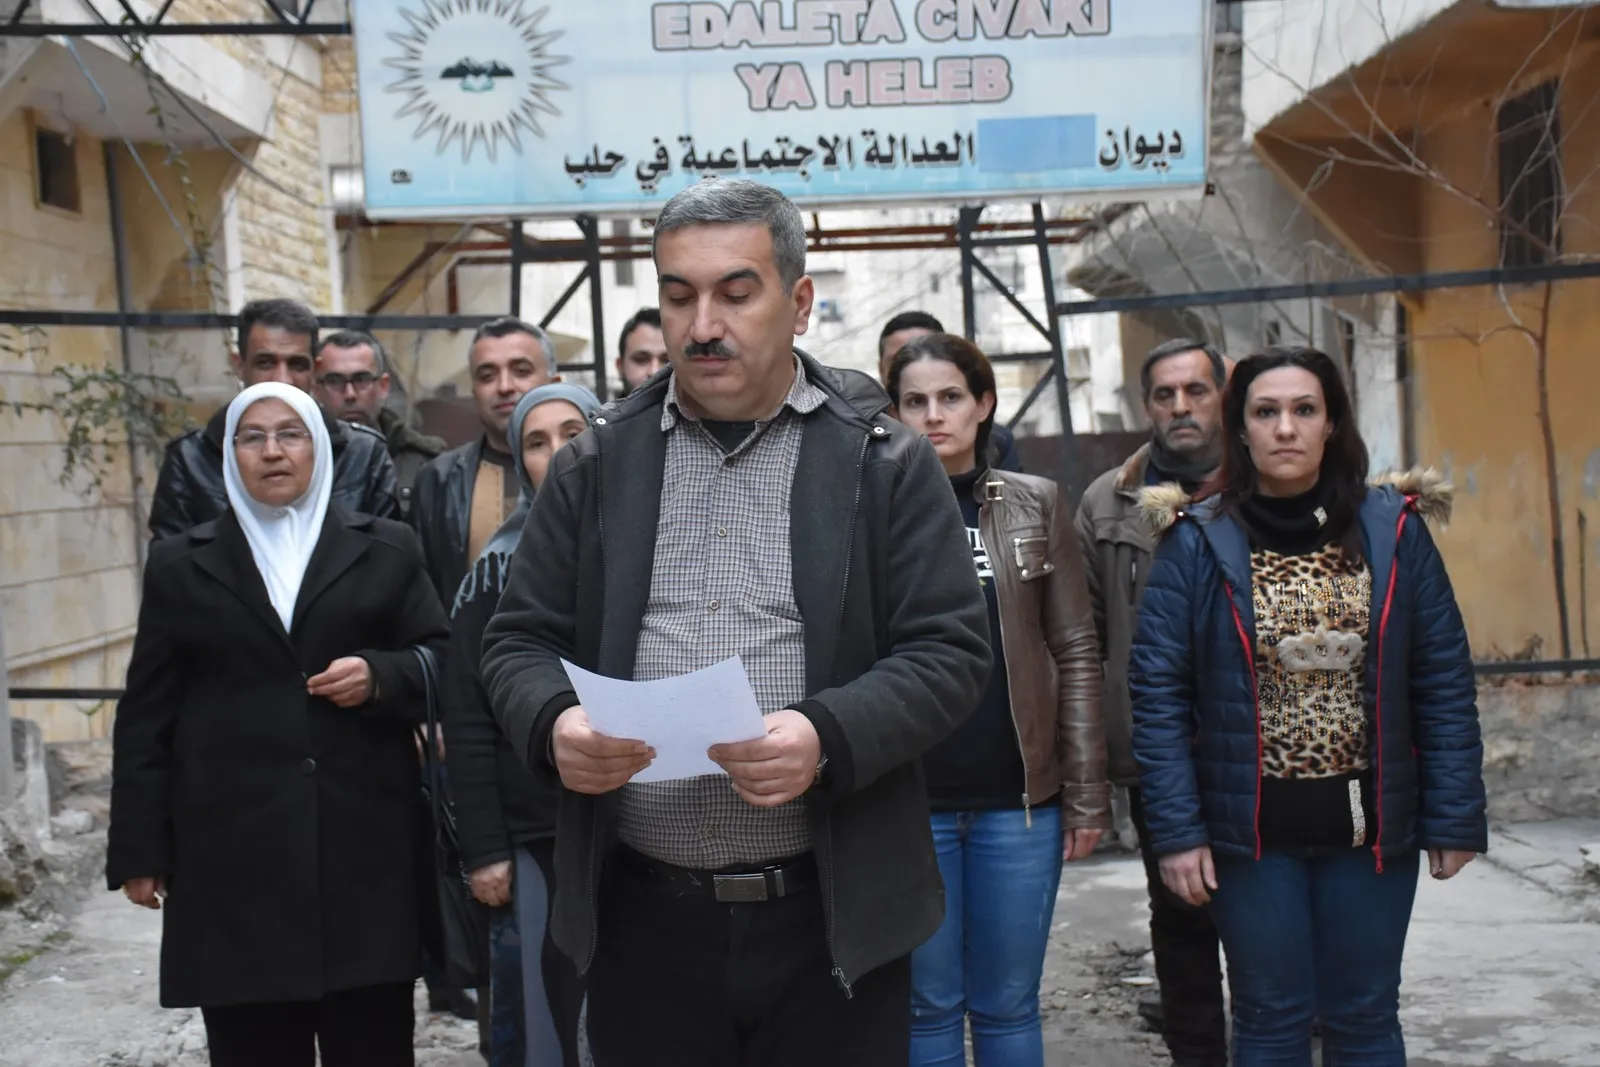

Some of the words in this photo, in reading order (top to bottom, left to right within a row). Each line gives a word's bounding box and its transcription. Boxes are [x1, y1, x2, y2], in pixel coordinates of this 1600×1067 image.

[652, 0, 906, 51] EDALETA
[734, 61, 816, 111] YA
[825, 55, 1013, 108] HELEB
[564, 142, 625, 185] حلب
[636, 136, 670, 190] في
[678, 134, 854, 180] الاجتماعية
[861, 129, 974, 165] العدالة
[1099, 126, 1183, 168] ديوان
